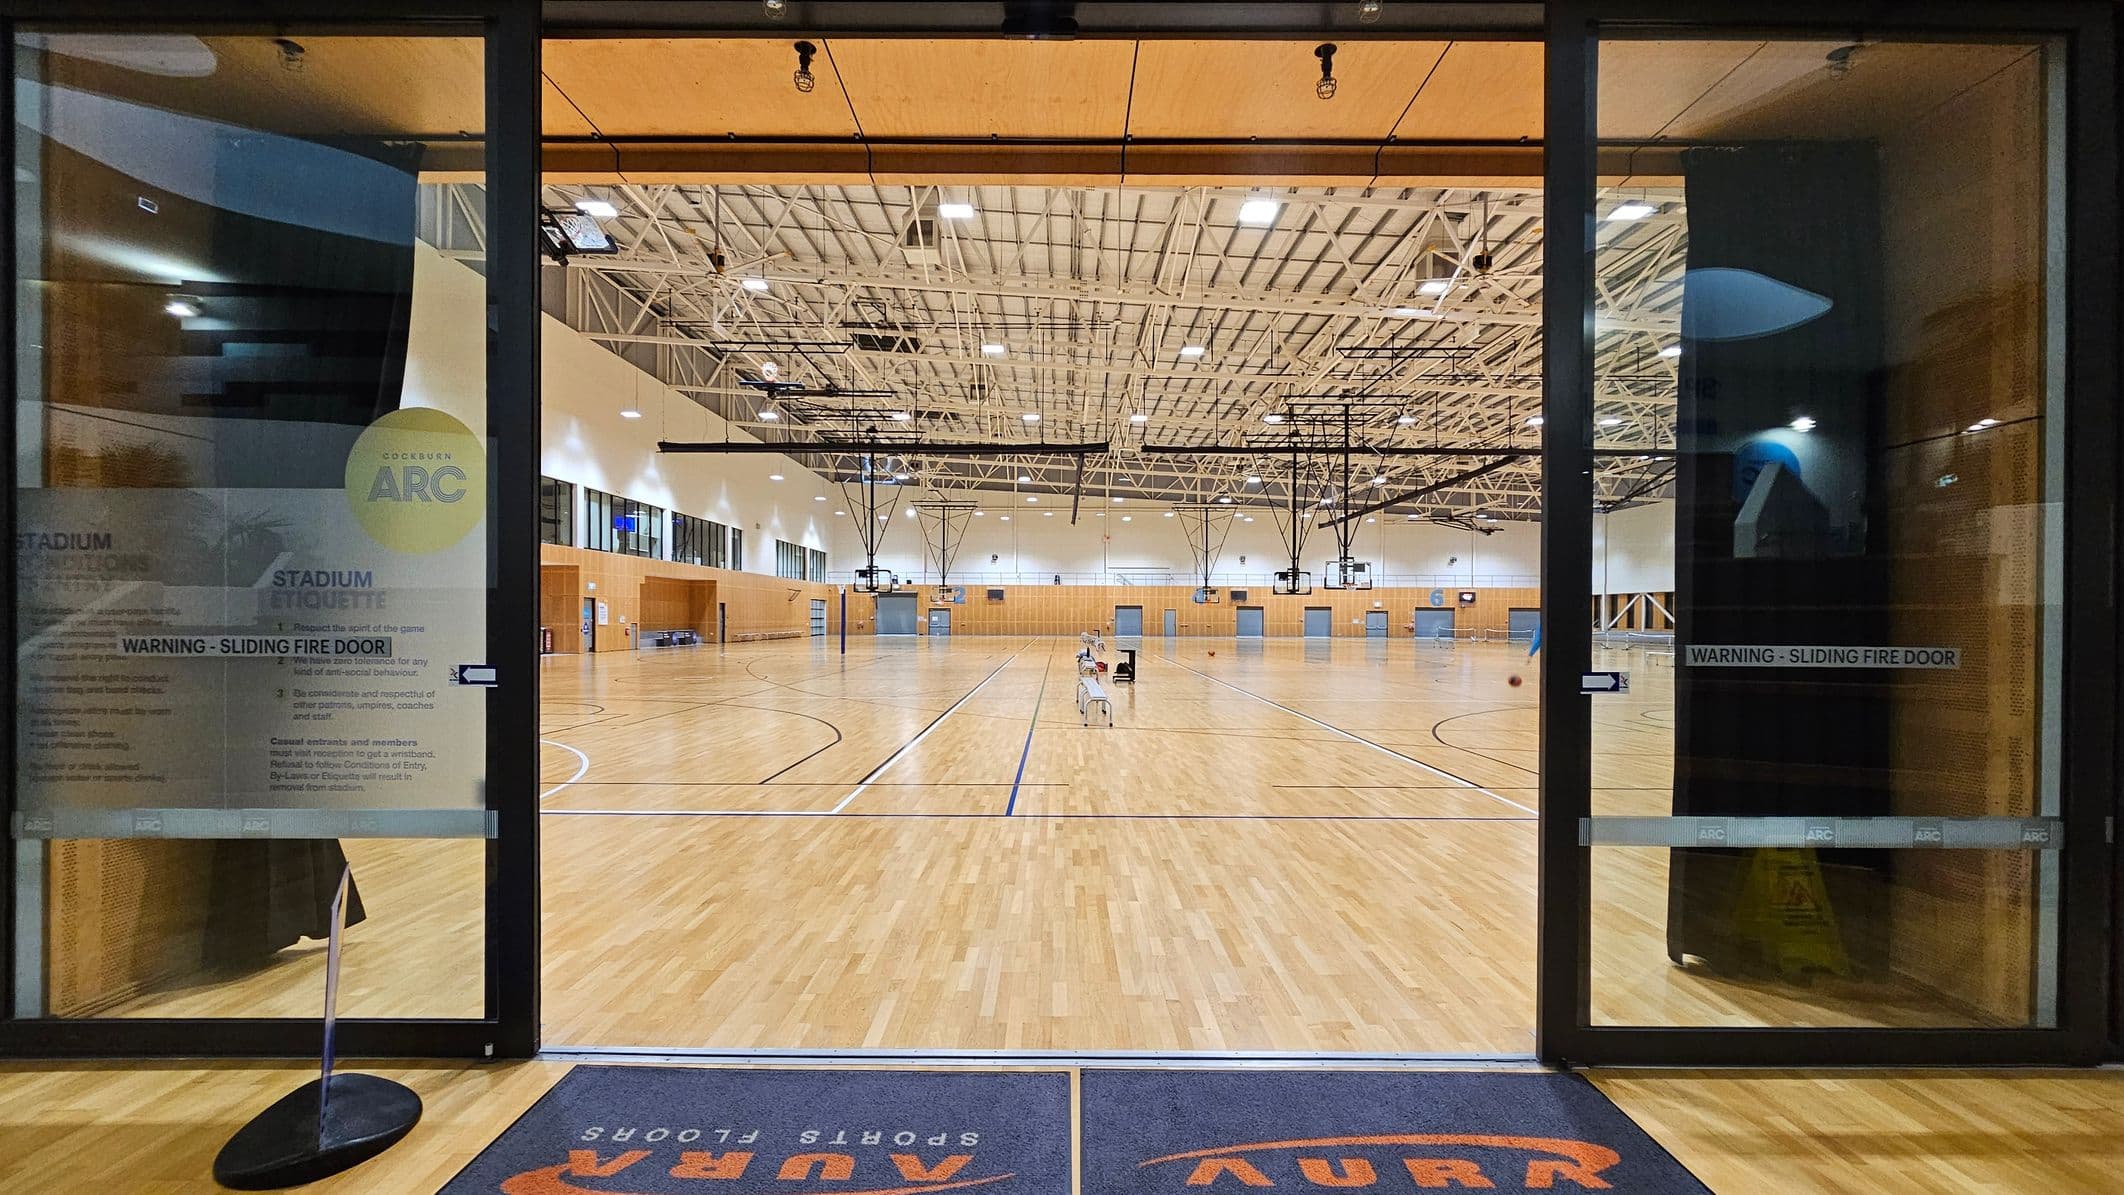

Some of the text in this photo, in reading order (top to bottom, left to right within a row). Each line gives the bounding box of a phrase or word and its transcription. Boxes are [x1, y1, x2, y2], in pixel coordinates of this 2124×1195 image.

[368, 466, 467, 503] ARC
[273, 570, 371, 587] STADIUM
[272, 590, 384, 608] ETIQUETTE
[953, 587, 966, 604] 2
[1430, 588, 1444, 606] 6
[294, 622, 330, 633] Respect
[333, 624, 345, 632] the
[348, 624, 370, 634] spirit
[372, 624, 382, 632] of
[384, 624, 398, 632] the
[400, 626, 424, 634] game
[122, 638, 205, 654] WARNING
[220, 639, 289, 654] SLIDING
[294, 639, 330, 654] FIRE
[334, 640, 385, 654] DOOR
[294, 656, 309, 665] We
[310, 656, 332, 665] have
[355, 657, 396, 665] tolerance
[399, 657, 409, 665] for
[412, 658, 428, 667] any
[1691, 648, 1774, 664] WARNING
[1789, 648, 1859, 664] SLIDING
[1864, 650, 1900, 665] FIRE
[1904, 650, 1956, 666] DOOR
[294, 667, 418, 677] kind of anti-social behaviour.
[276, 688, 284, 697] 3
[294, 689, 306, 697] Be
[362, 690, 378, 698] and
[380, 690, 424, 699] respectful
[426, 690, 435, 698] of
[397, 702, 434, 710] coaches
[271, 737, 418, 747] Casual entrants and members
[314, 750, 354, 758] reception
[367, 751, 382, 759] get
[391, 750, 436, 758] wristband.
[316, 761, 341, 769] follow
[344, 760, 390, 769] Conditions
[270, 772, 308, 781] By-Laws
[379, 773, 402, 781] result
[404, 773, 413, 781] in
[306, 783, 326, 792] from
[135, 820, 161, 831] ARC
[244, 820, 269, 831] ARC
[1700, 829, 1725, 840] ARC
[1807, 830, 1833, 841] ARC
[1914, 831, 1941, 841] ARC
[2023, 832, 2049, 842] ARC
[582, 1126, 980, 1146] SPORTS FLOORS
[568, 1150, 975, 1182] AURA
[1186, 1158, 1613, 1189] AURA
